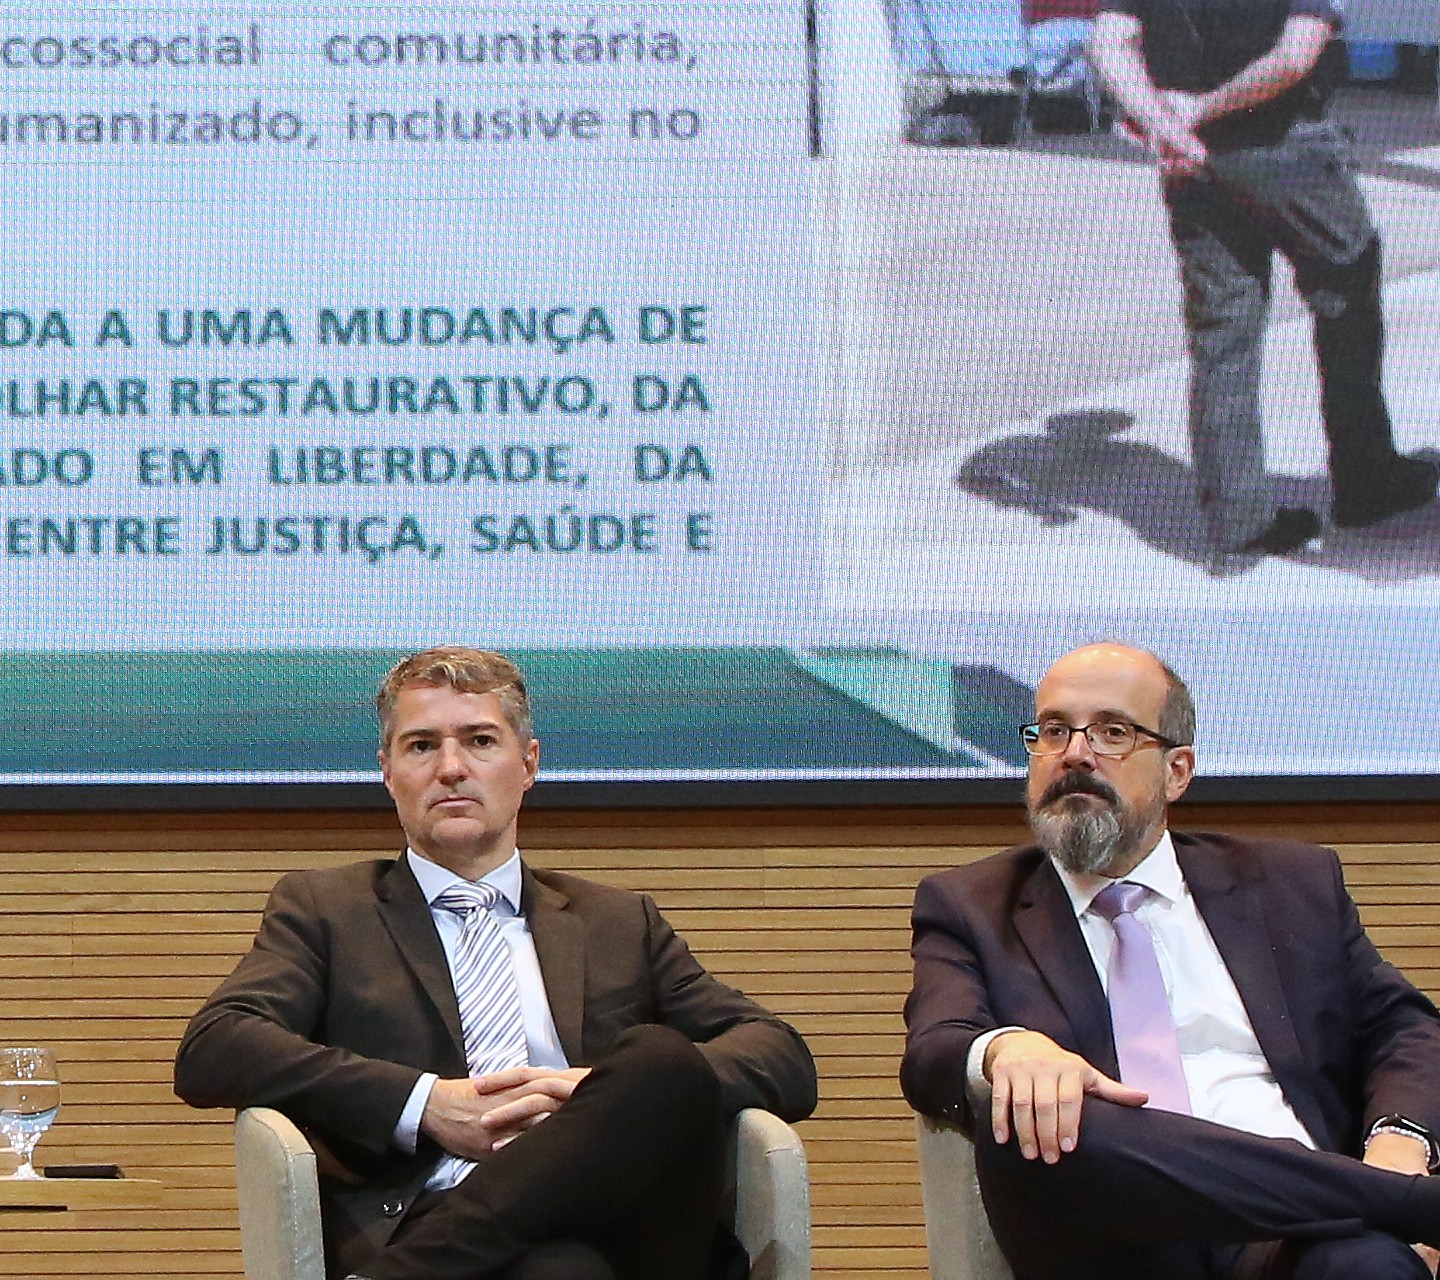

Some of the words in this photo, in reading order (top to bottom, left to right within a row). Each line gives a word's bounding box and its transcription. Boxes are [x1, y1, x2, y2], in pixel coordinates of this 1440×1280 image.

[322, 19, 697, 70] comunitária,
[346, 98, 602, 141] inclusive
[628, 108, 702, 140] no
[95, 308, 134, 348] A
[156, 307, 295, 348] UMA
[317, 305, 616, 355] MUDANÇA
[637, 304, 707, 345] DE
[169, 374, 611, 419] RESTAURATIVO,
[632, 373, 711, 415] DA
[137, 446, 223, 487] EM
[267, 444, 588, 489] LIBERDADE,
[633, 443, 713, 484] DA
[5, 516, 178, 557] ENTRE
[206, 514, 444, 566] JUSTIÇA,
[471, 505, 656, 555] SAÚDE
[685, 512, 712, 554] E
